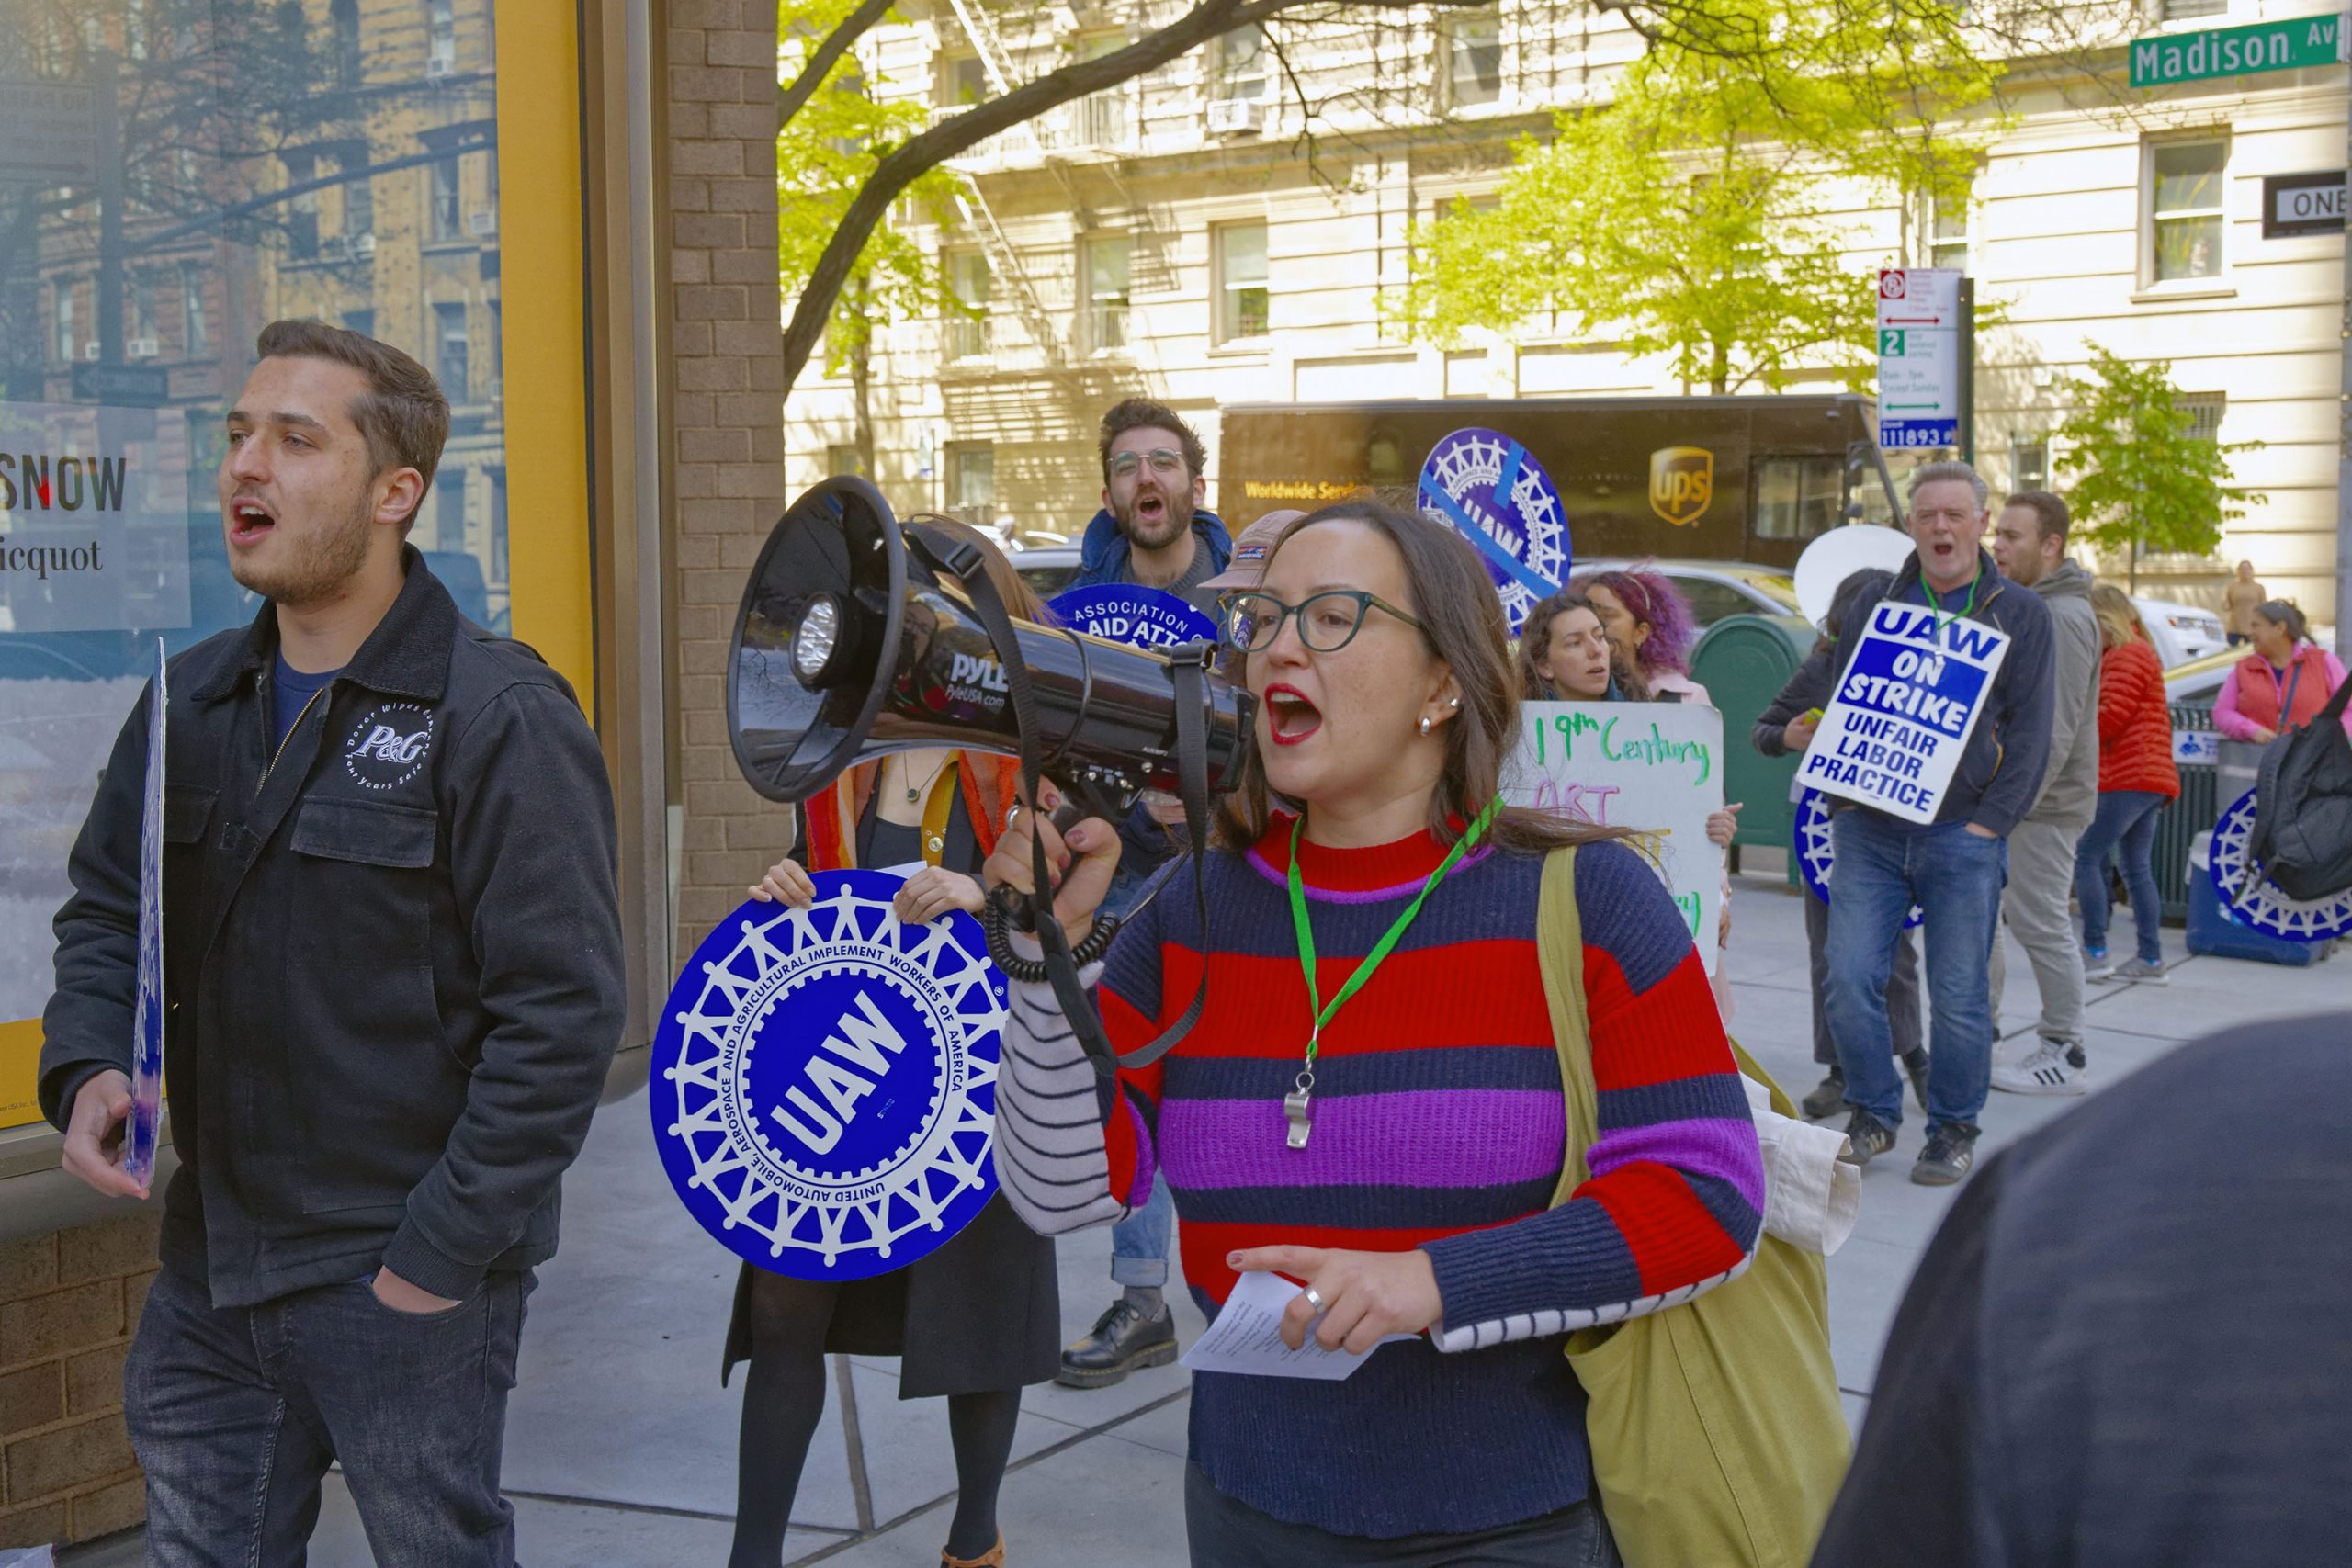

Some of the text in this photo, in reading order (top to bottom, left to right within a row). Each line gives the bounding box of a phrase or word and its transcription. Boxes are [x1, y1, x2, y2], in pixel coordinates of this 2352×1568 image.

[2136, 22, 2335, 82] Madison Av
[2294, 188, 2346, 217] ONE
[1884, 331, 1900, 355] 2
[1882, 428, 1939, 446] 111893
[0, 453, 127, 512] SNOW
[1244, 479, 1317, 499] Worldwide
[1656, 470, 1707, 513] ups
[0, 536, 104, 580] icquot
[1075, 601, 1189, 634] ASSOCIATION
[1088, 616, 1189, 647] AID ATT
[1874, 607, 2003, 661] UAW
[950, 651, 1009, 692] PYLE
[1892, 649, 1946, 687] ON
[1844, 672, 1968, 732] STRIKE
[351, 724, 428, 764] P&G
[1600, 716, 1710, 786] Century
[1844, 712, 1939, 757] UNFAIR
[1837, 736, 1923, 780] LABOR
[1807, 754, 1934, 812] PRACTICE
[721, 945, 964, 1202] UNITED AUTOMOBILE, AEROSPACE AND AGRICULTURAL IMPLEMENT WORKERS OF AMERICA
[770, 989, 907, 1156] UAW
